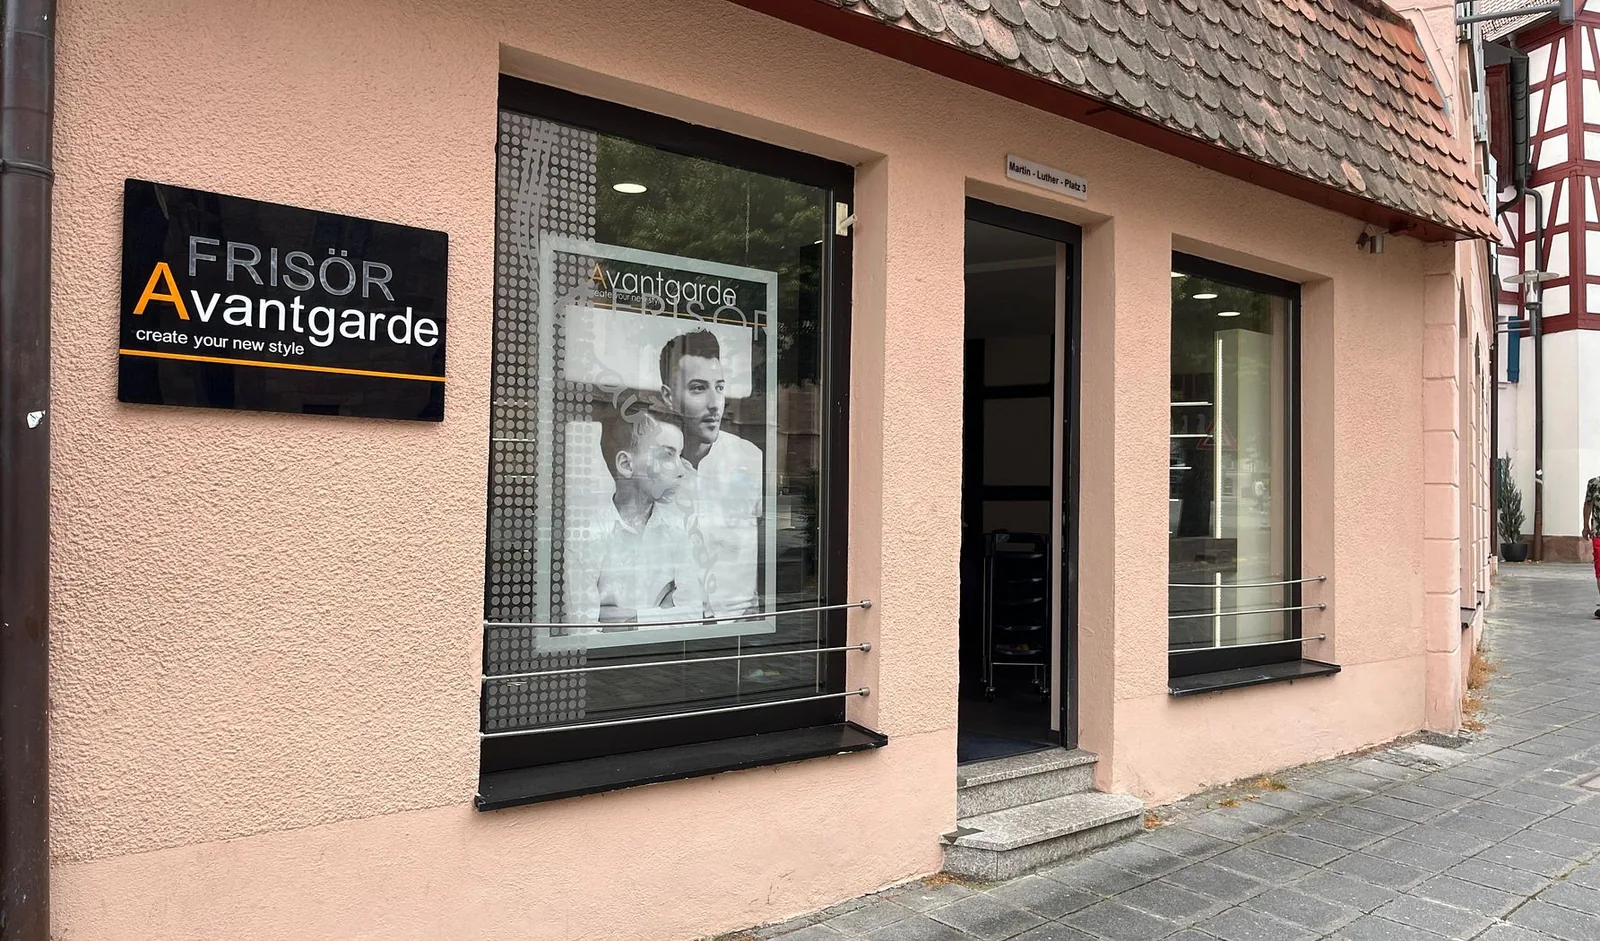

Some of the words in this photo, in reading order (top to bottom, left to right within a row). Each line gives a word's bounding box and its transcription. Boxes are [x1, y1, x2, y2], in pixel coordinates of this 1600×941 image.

[1009, 161, 1031, 177] Martin
[1036, 170, 1059, 185] Luther
[1064, 179, 1081, 192] Platz
[1081, 184, 1087, 193] 3
[187, 235, 396, 302] FRISÖR
[590, 262, 737, 308] Avantgarde
[132, 261, 439, 347] Avantgarde
[135, 328, 188, 345] create
[193, 333, 229, 350] your
[232, 337, 265, 352] new
[268, 340, 305, 357] style
